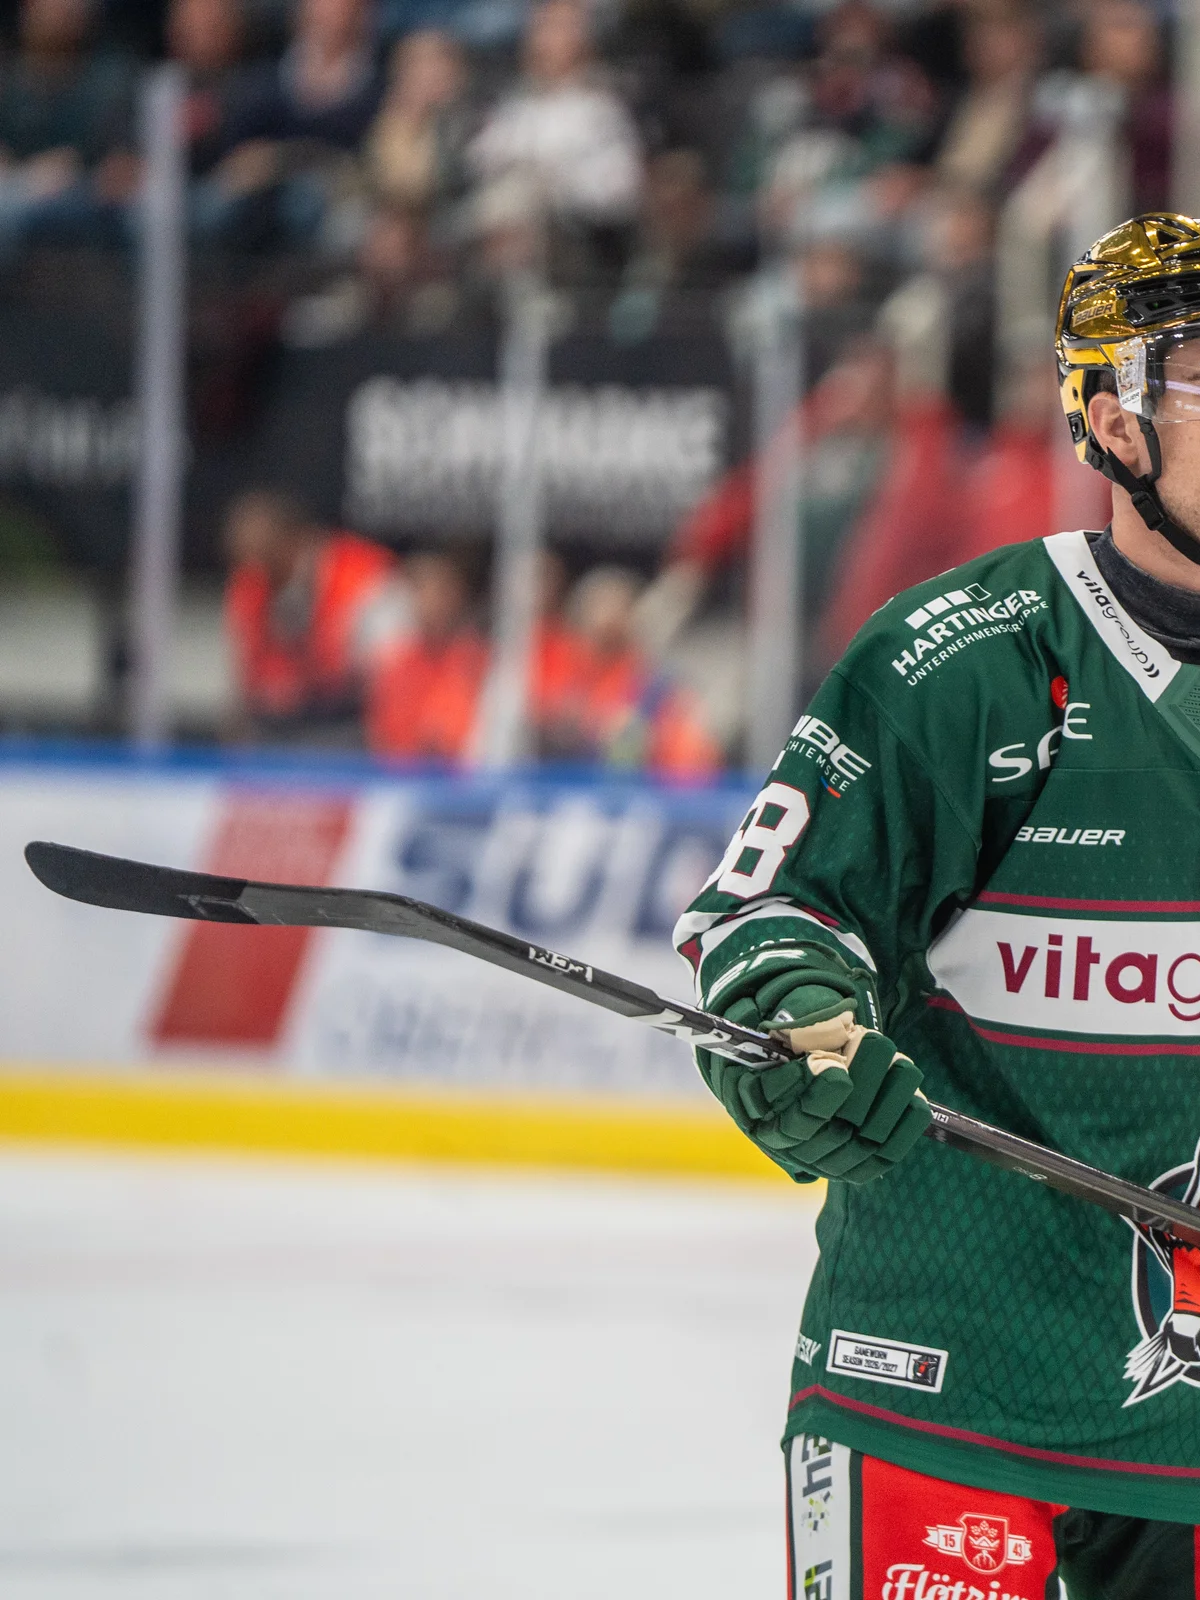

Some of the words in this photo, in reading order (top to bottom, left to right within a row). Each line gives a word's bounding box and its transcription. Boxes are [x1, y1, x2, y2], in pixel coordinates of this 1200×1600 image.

[1075, 303, 1114, 324] BAUER
[891, 589, 1042, 677] HARTINGER
[907, 600, 1049, 687] UNTERNEHMENSGRUPPE
[1015, 826, 1127, 846] BAUER
[942, 1533, 957, 1548] 15
